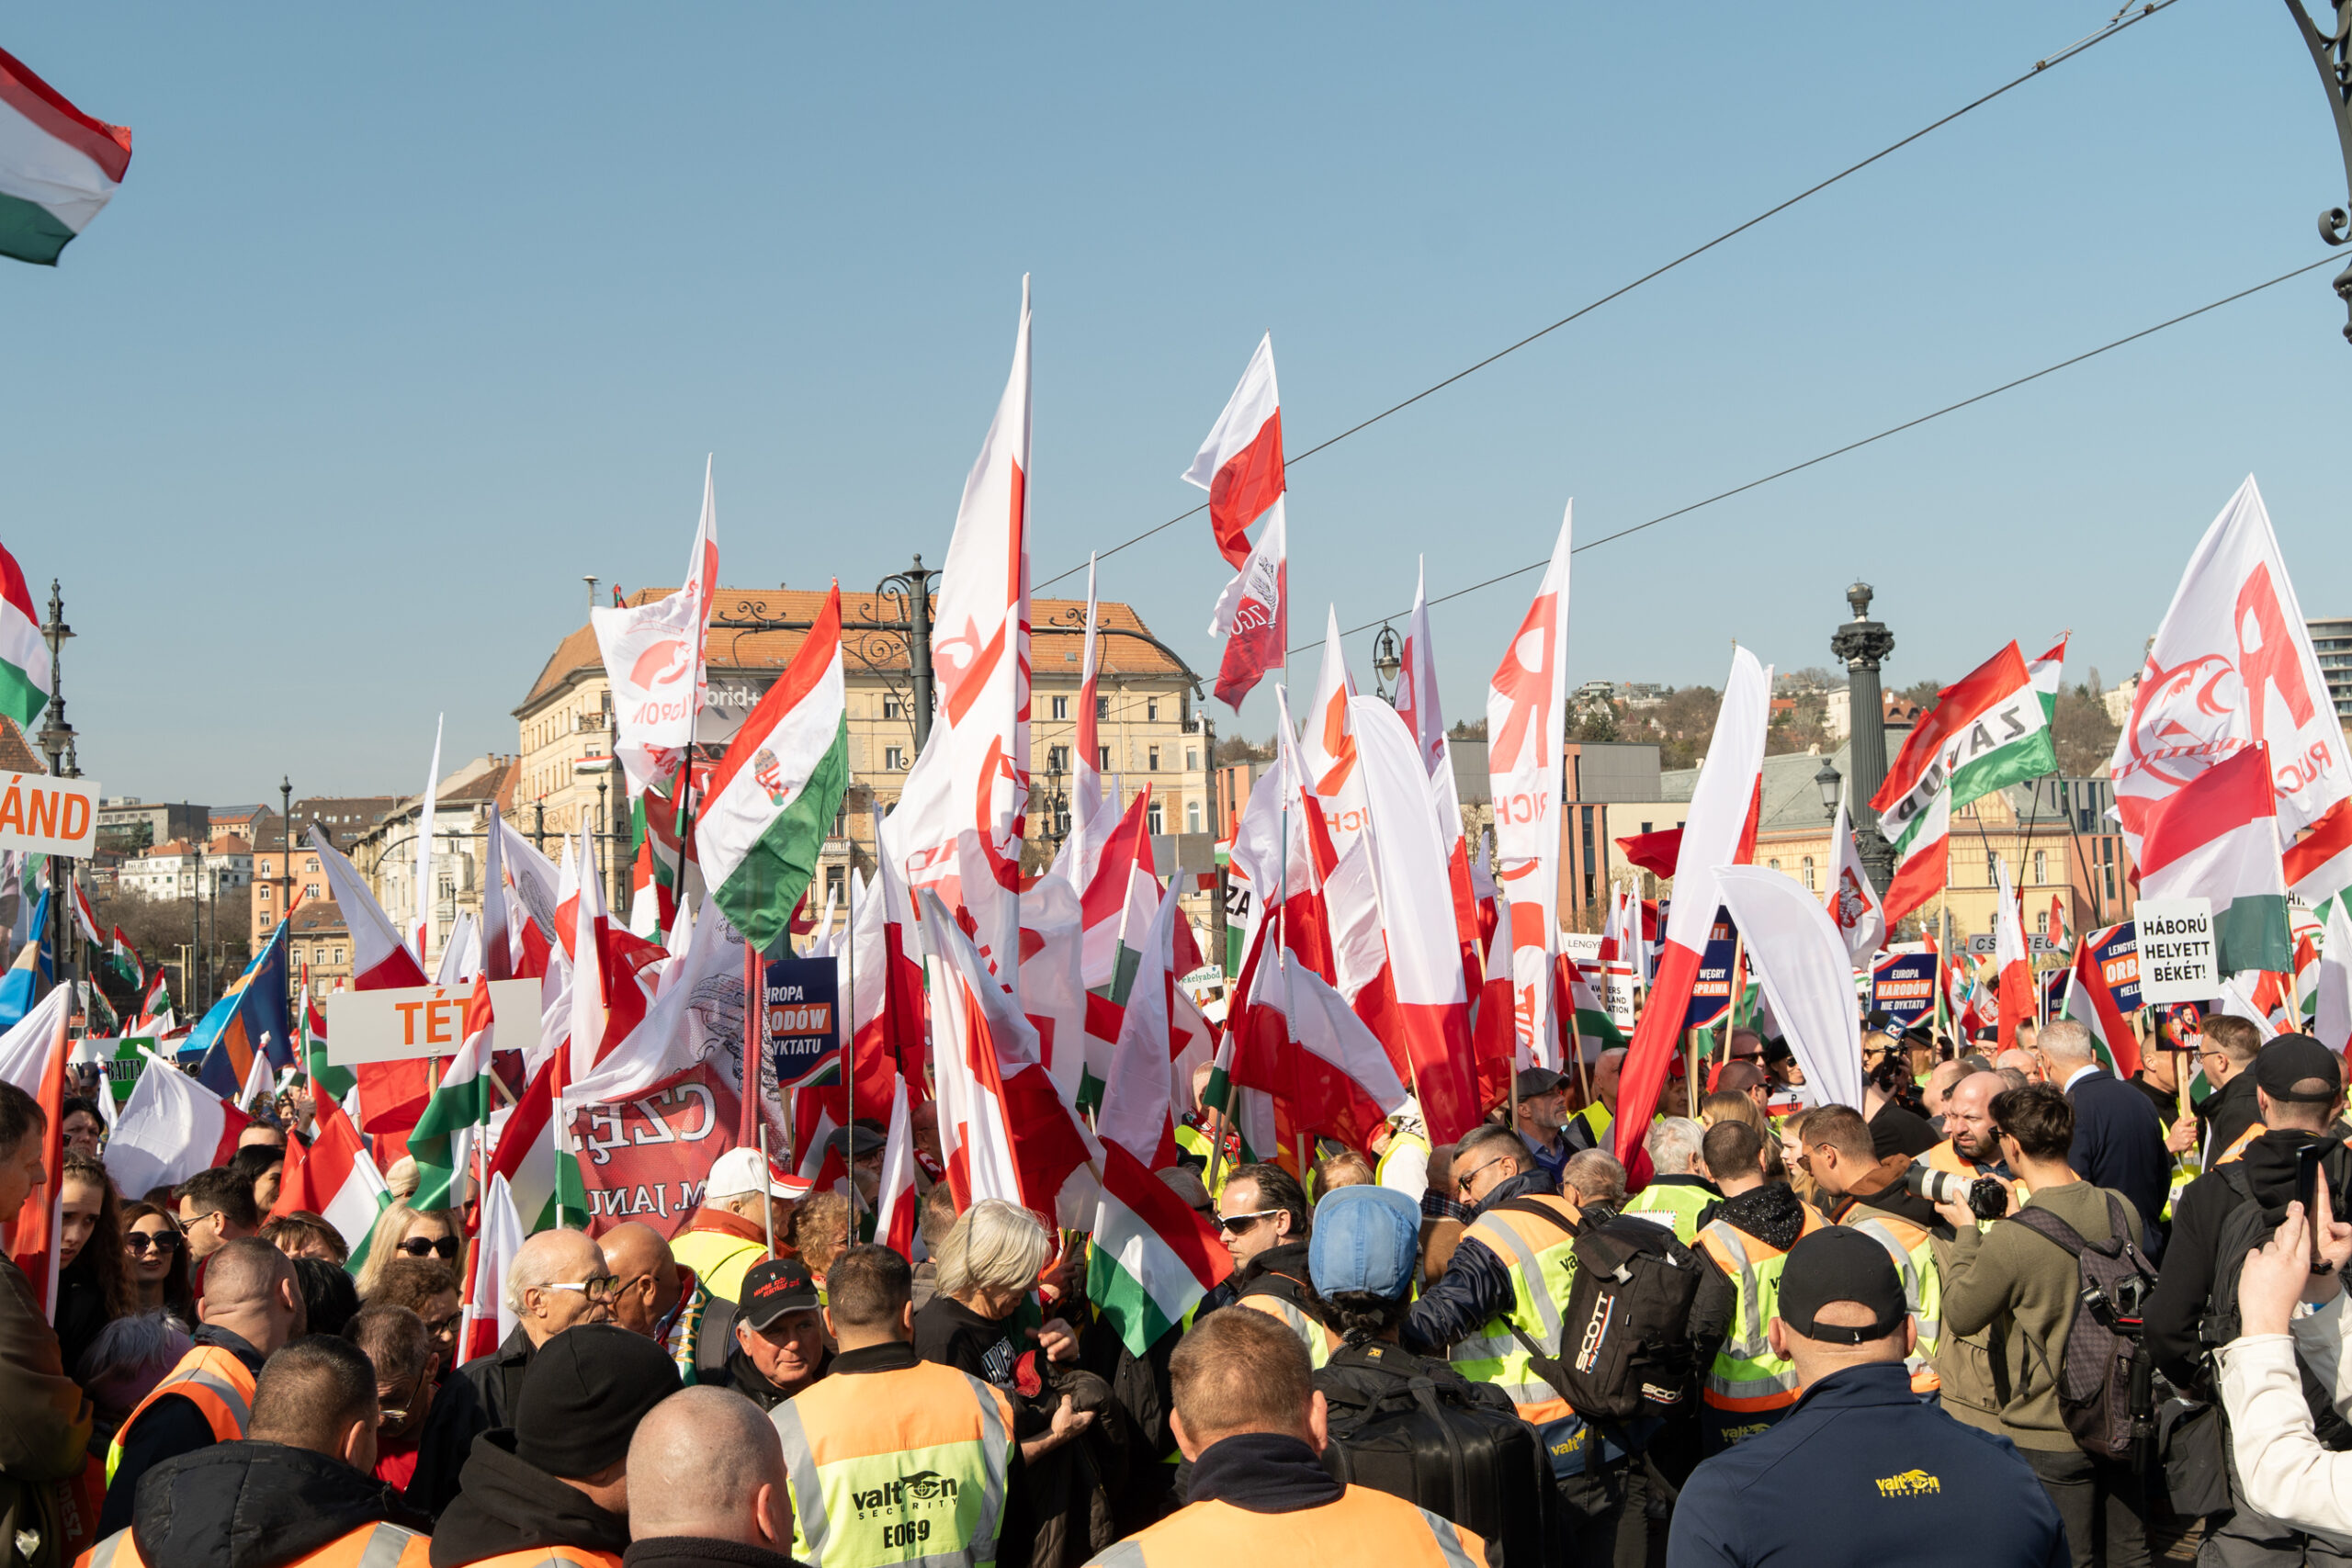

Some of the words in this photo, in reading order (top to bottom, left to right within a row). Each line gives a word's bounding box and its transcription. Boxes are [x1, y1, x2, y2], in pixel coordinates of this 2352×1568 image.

[0, 774, 90, 840] ÁND
[2143, 913, 2207, 936] HÁBORÚ
[2145, 942, 2210, 959] HELYETT
[1699, 968, 1726, 981] WĘGRY
[1891, 969, 1919, 979] EUROPA
[2106, 958, 2140, 984] ORB
[2154, 961, 2206, 982] BÉKÉT!
[1878, 980, 1930, 997] NARODÓW
[1607, 1005, 1629, 1014] ATION
[1881, 1000, 1894, 1010] NIE
[1894, 999, 1926, 1010] DYKTATU
[772, 1005, 827, 1032] ODÓW
[773, 1038, 821, 1055] YKTATU
[1575, 1291, 1608, 1372] SCOTT
[858, 1497, 957, 1520] SECURITY
[883, 1519, 931, 1550] E069
